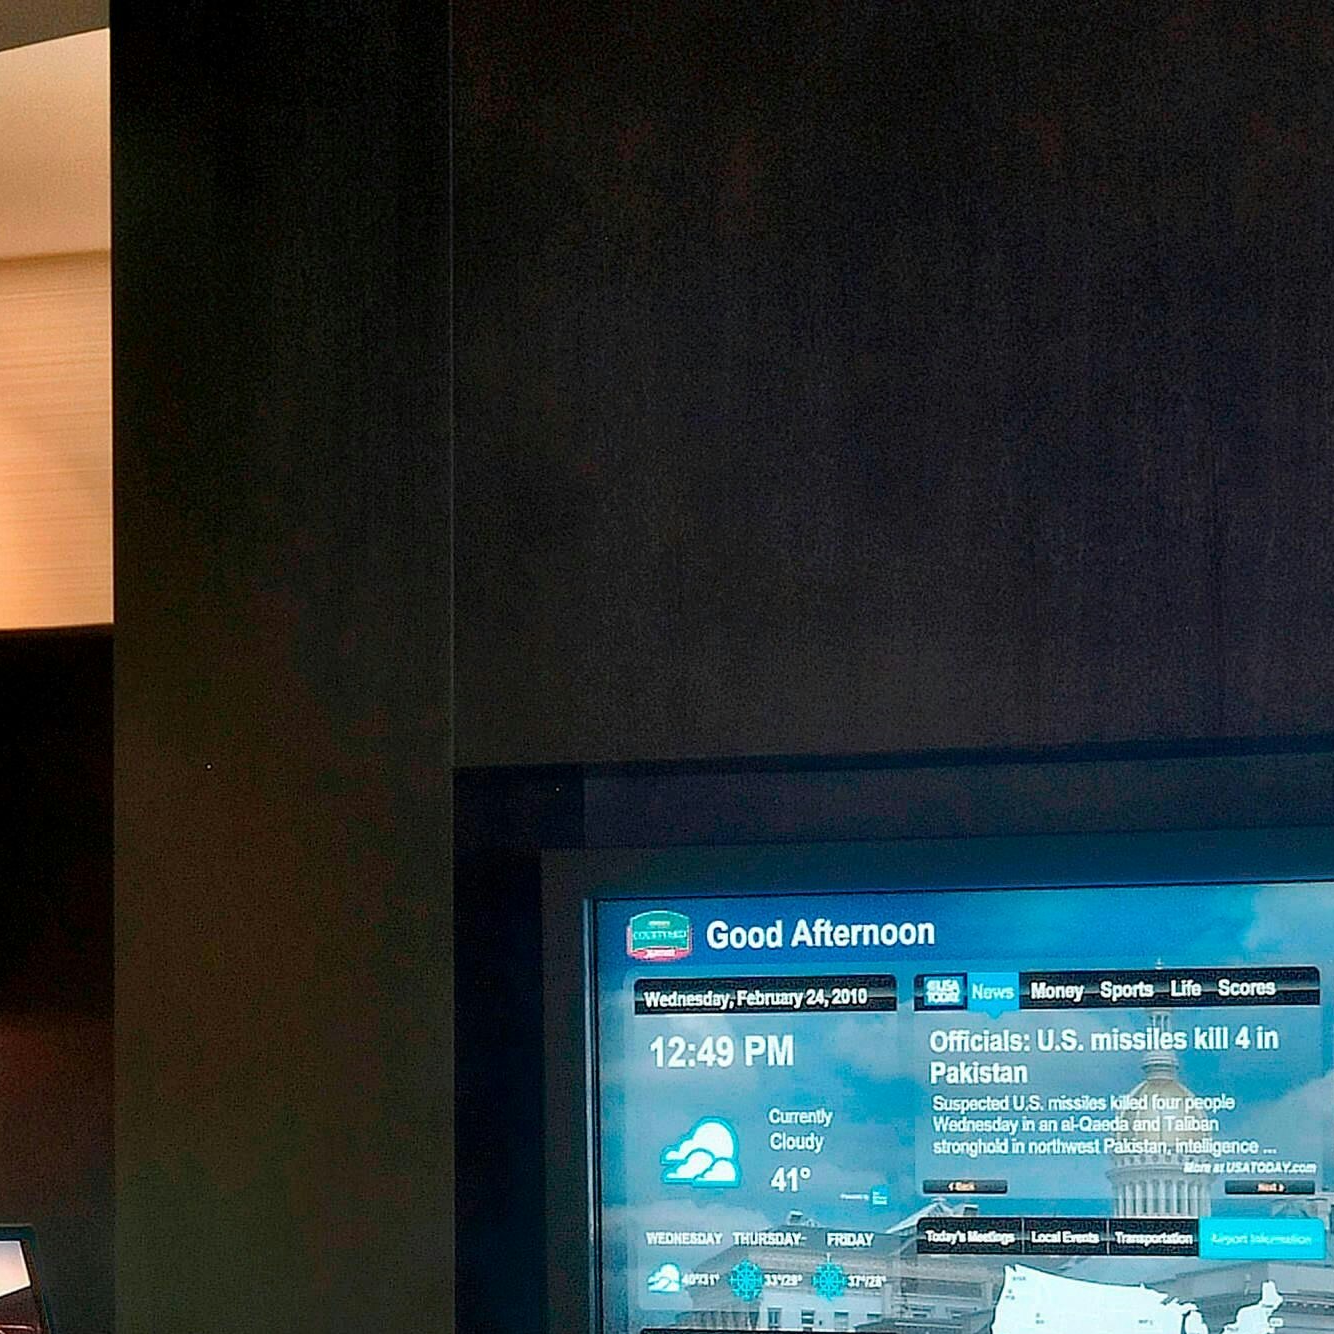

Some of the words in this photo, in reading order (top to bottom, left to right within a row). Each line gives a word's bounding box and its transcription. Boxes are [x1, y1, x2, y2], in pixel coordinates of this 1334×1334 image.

[706, 920, 782, 950] Good
[791, 919, 935, 948] Afternoon
[971, 983, 1015, 999] News
[1031, 982, 1084, 1002] Money
[1100, 980, 1154, 998] Sports
[1170, 978, 1202, 997] Life
[1218, 979, 1277, 997] Scores
[644, 990, 735, 1009] Wednesday,
[737, 989, 803, 1009] February
[805, 989, 831, 1008] 24,
[832, 988, 868, 1005] 2010
[930, 1029, 1031, 1054] Officials:
[1037, 1028, 1083, 1053] U.S.
[1091, 1028, 1187, 1052] missiles
[1194, 1026, 1229, 1050] kill
[1234, 1026, 1250, 1049] 4
[1257, 1026, 1280, 1050] in
[650, 1035, 735, 1068] 12:49
[744, 1034, 794, 1066] PM
[930, 1060, 1028, 1085] Pakistan
[933, 1095, 1009, 1114] Suspected
[1012, 1094, 1044, 1111] U.S.
[1048, 1094, 1107, 1112] missiles
[1110, 1094, 1146, 1111] killed
[1151, 1094, 1181, 1111] four
[1184, 1094, 1236, 1115] people
[769, 1108, 833, 1128] Currently
[933, 1116, 1018, 1136] Wednesday
[1022, 1116, 1035, 1132] in
[1038, 1119, 1058, 1132] an
[1061, 1115, 1129, 1134] al-Qaeda
[1132, 1115, 1160, 1132] and
[1165, 1115, 1219, 1132] Taliban
[770, 1132, 824, 1153] Cloudy
[933, 1138, 1009, 1158] stronghold
[1012, 1138, 1025, 1154] in
[1028, 1138, 1101, 1154] northwest
[1104, 1138, 1172, 1157] Pakistan,
[1175, 1138, 1259, 1157] intelligence
[771, 1166, 811, 1192] 41°
[646, 1232, 723, 1246] WEDNESDAY
[732, 1232, 801, 1246] THURSDAY
[827, 1233, 875, 1247] FRIDAY
[925, 1230, 967, 1246] Today's
[968, 1230, 1015, 1246] Meetings
[1031, 1230, 1061, 1245] Local
[1062, 1231, 1100, 1245] Events
[1115, 1231, 1194, 1247] Transportation
